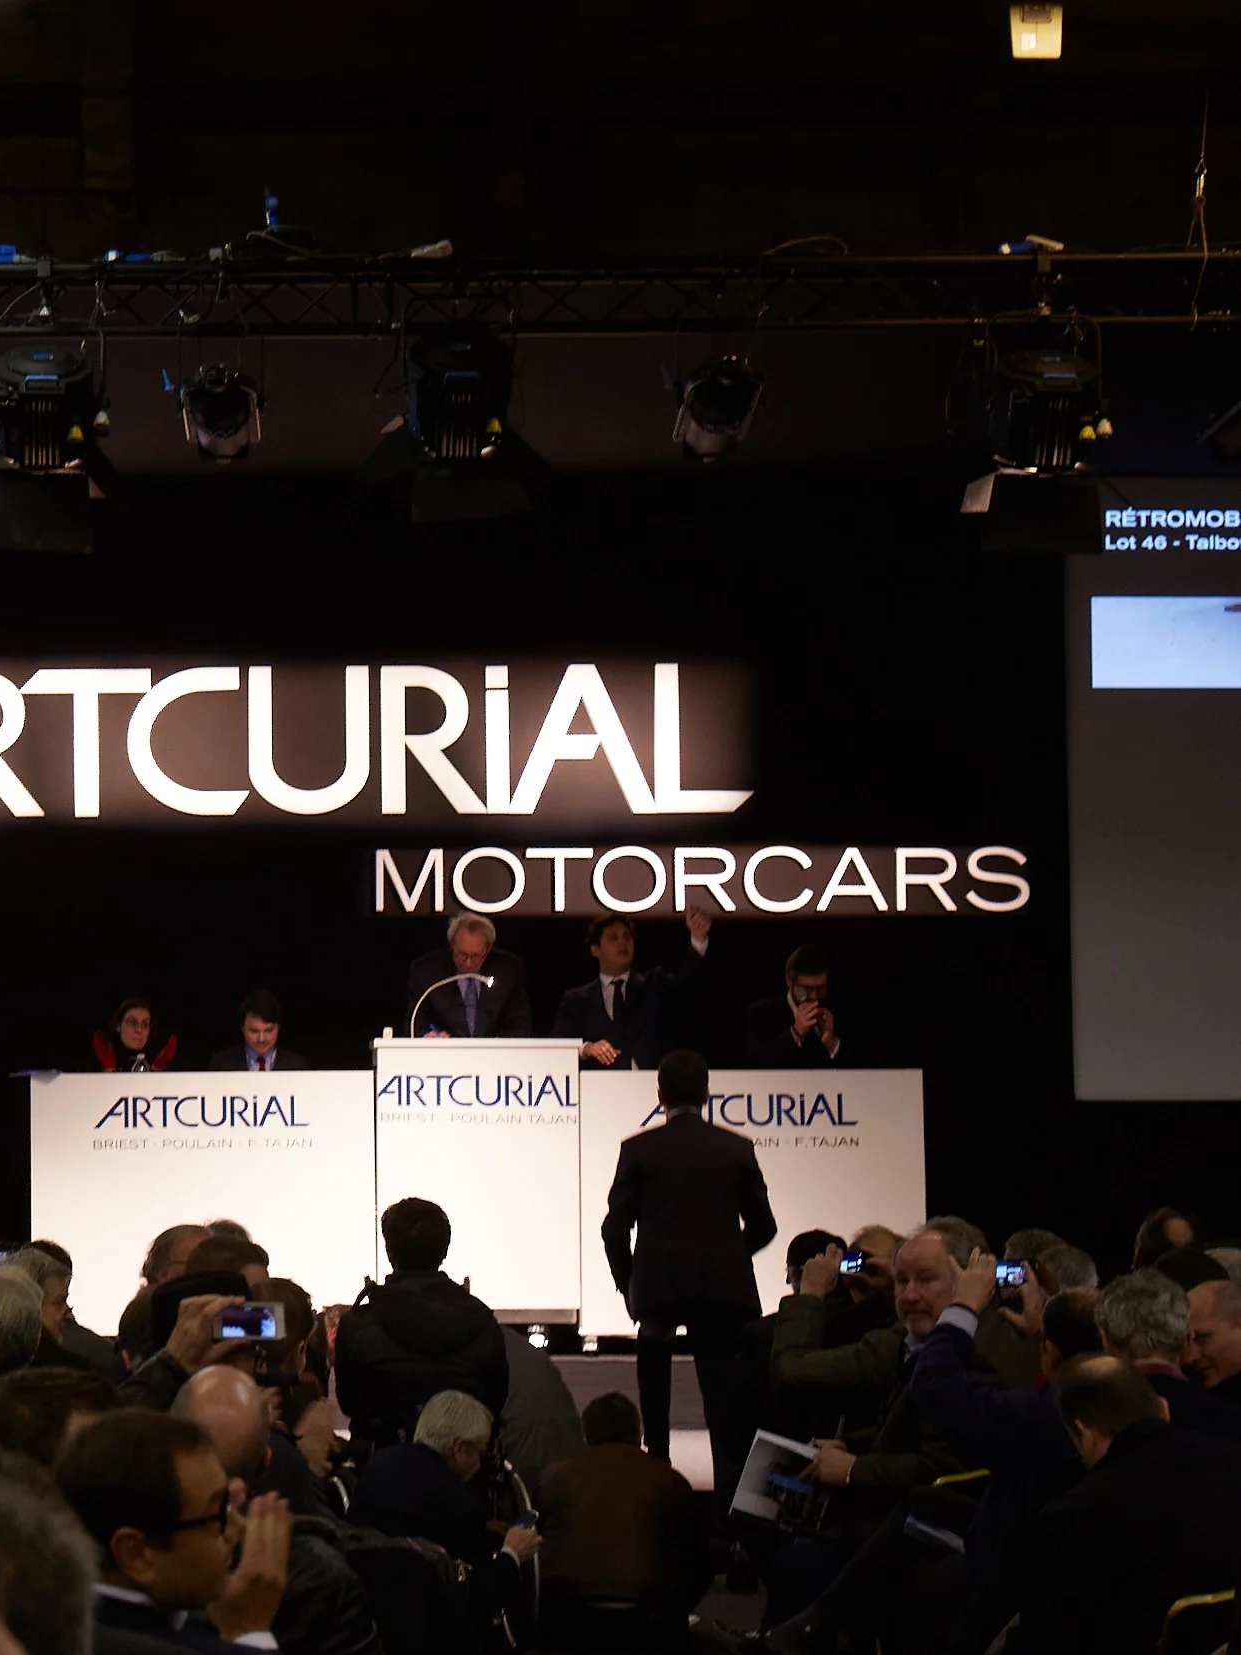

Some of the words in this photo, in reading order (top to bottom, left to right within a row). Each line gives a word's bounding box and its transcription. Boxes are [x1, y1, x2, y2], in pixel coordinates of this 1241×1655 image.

[1105, 506, 1241, 528] RÉTROMOB
[1105, 534, 1137, 550] Lot
[1141, 534, 1168, 551] 46
[1185, 533, 1241, 551] Talbo
[374, 844, 1031, 914] MOTORCARS
[527, 1113, 577, 1124] TAJAN
